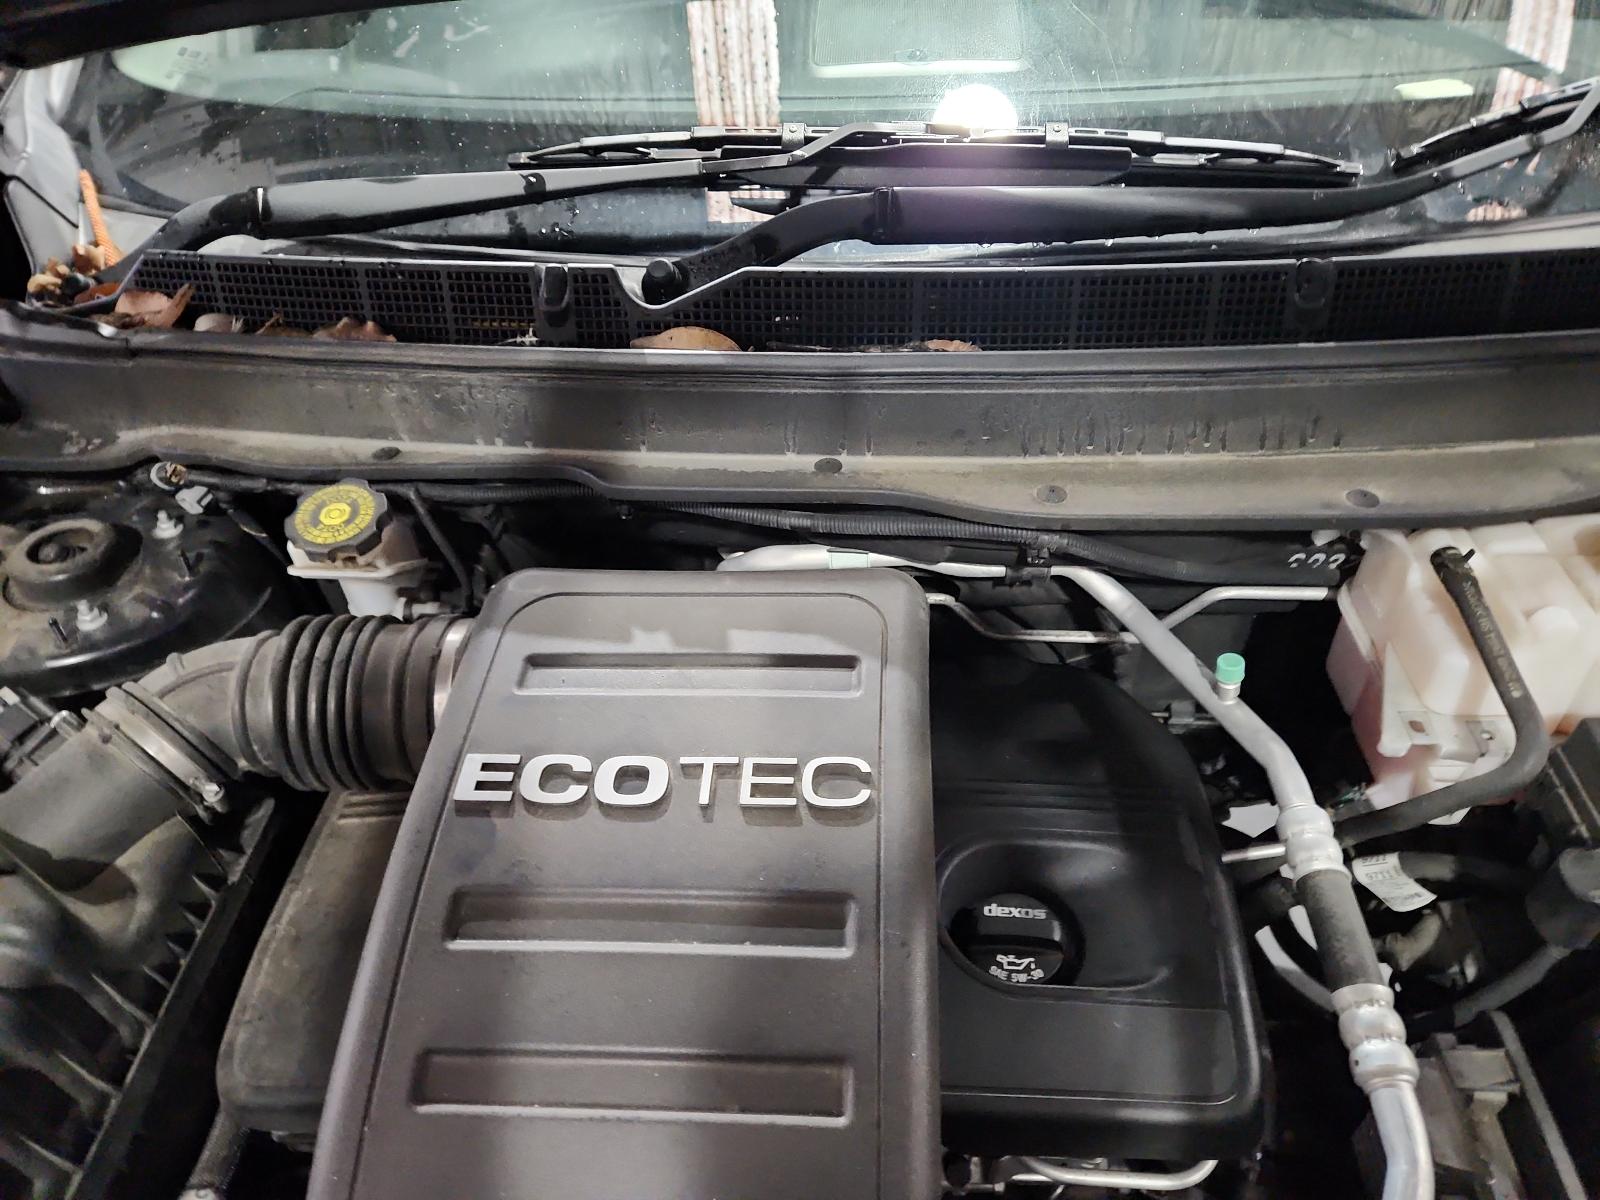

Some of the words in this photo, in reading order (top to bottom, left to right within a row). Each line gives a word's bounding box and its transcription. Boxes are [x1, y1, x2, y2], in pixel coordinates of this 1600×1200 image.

[453, 753, 872, 807] ECOTEC
[983, 903, 1047, 920] dexos
[989, 966, 1009, 980] SAE
